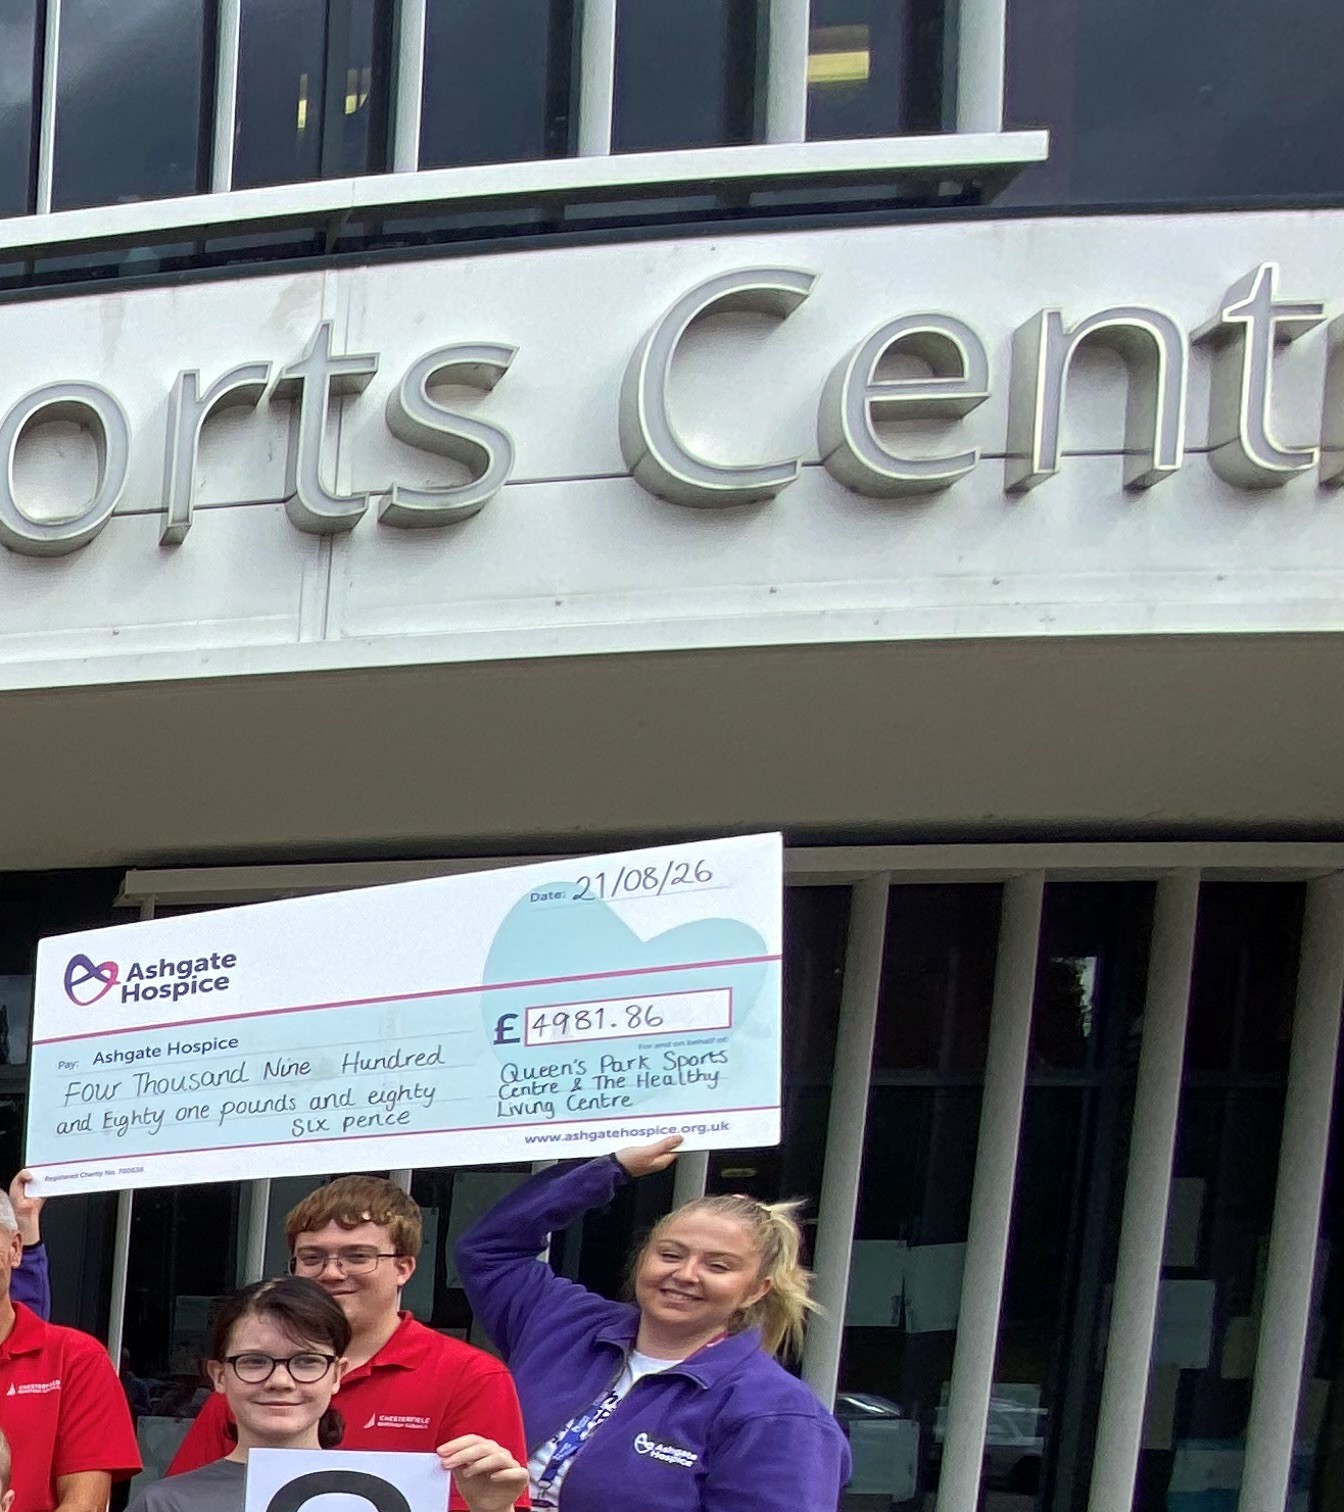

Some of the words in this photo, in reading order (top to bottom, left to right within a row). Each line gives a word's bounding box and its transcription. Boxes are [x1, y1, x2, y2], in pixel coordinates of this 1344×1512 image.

[618, 262, 1344, 510] Cent
[572, 859, 713, 900] 21/08/26
[530, 891, 566, 903] Date:
[126, 952, 238, 982] Ashgate
[121, 975, 230, 1004] Hospice
[493, 1013, 520, 1045] £
[532, 1004, 663, 1037] 4981.86
[58, 1060, 79, 1070] Pay:
[93, 1046, 162, 1065] Ashgate
[167, 1036, 240, 1056] Hospice
[64, 1081, 123, 1107] Four
[133, 1061, 249, 1097] Thousand
[263, 1057, 312, 1080] Nine
[342, 1045, 445, 1074] Hundred
[501, 1059, 587, 1084] Queen's
[601, 1054, 651, 1073] Park
[664, 1050, 728, 1071] Sports
[499, 1081, 559, 1100] Centre
[571, 1077, 583, 1092] &
[592, 1075, 626, 1091] The
[637, 1068, 721, 1090] Healthy
[56, 1113, 92, 1135] and
[103, 1107, 166, 1137] Eighty
[175, 1103, 210, 1121] one
[219, 1094, 296, 1126] pounds
[310, 1088, 356, 1111] and
[368, 1083, 436, 1111] eighty
[343, 1110, 411, 1132] pence
[497, 1100, 555, 1120] Living
[567, 1093, 634, 1112] Centre
[525, 1121, 730, 1145] www.ashgatehospice.org.uk
